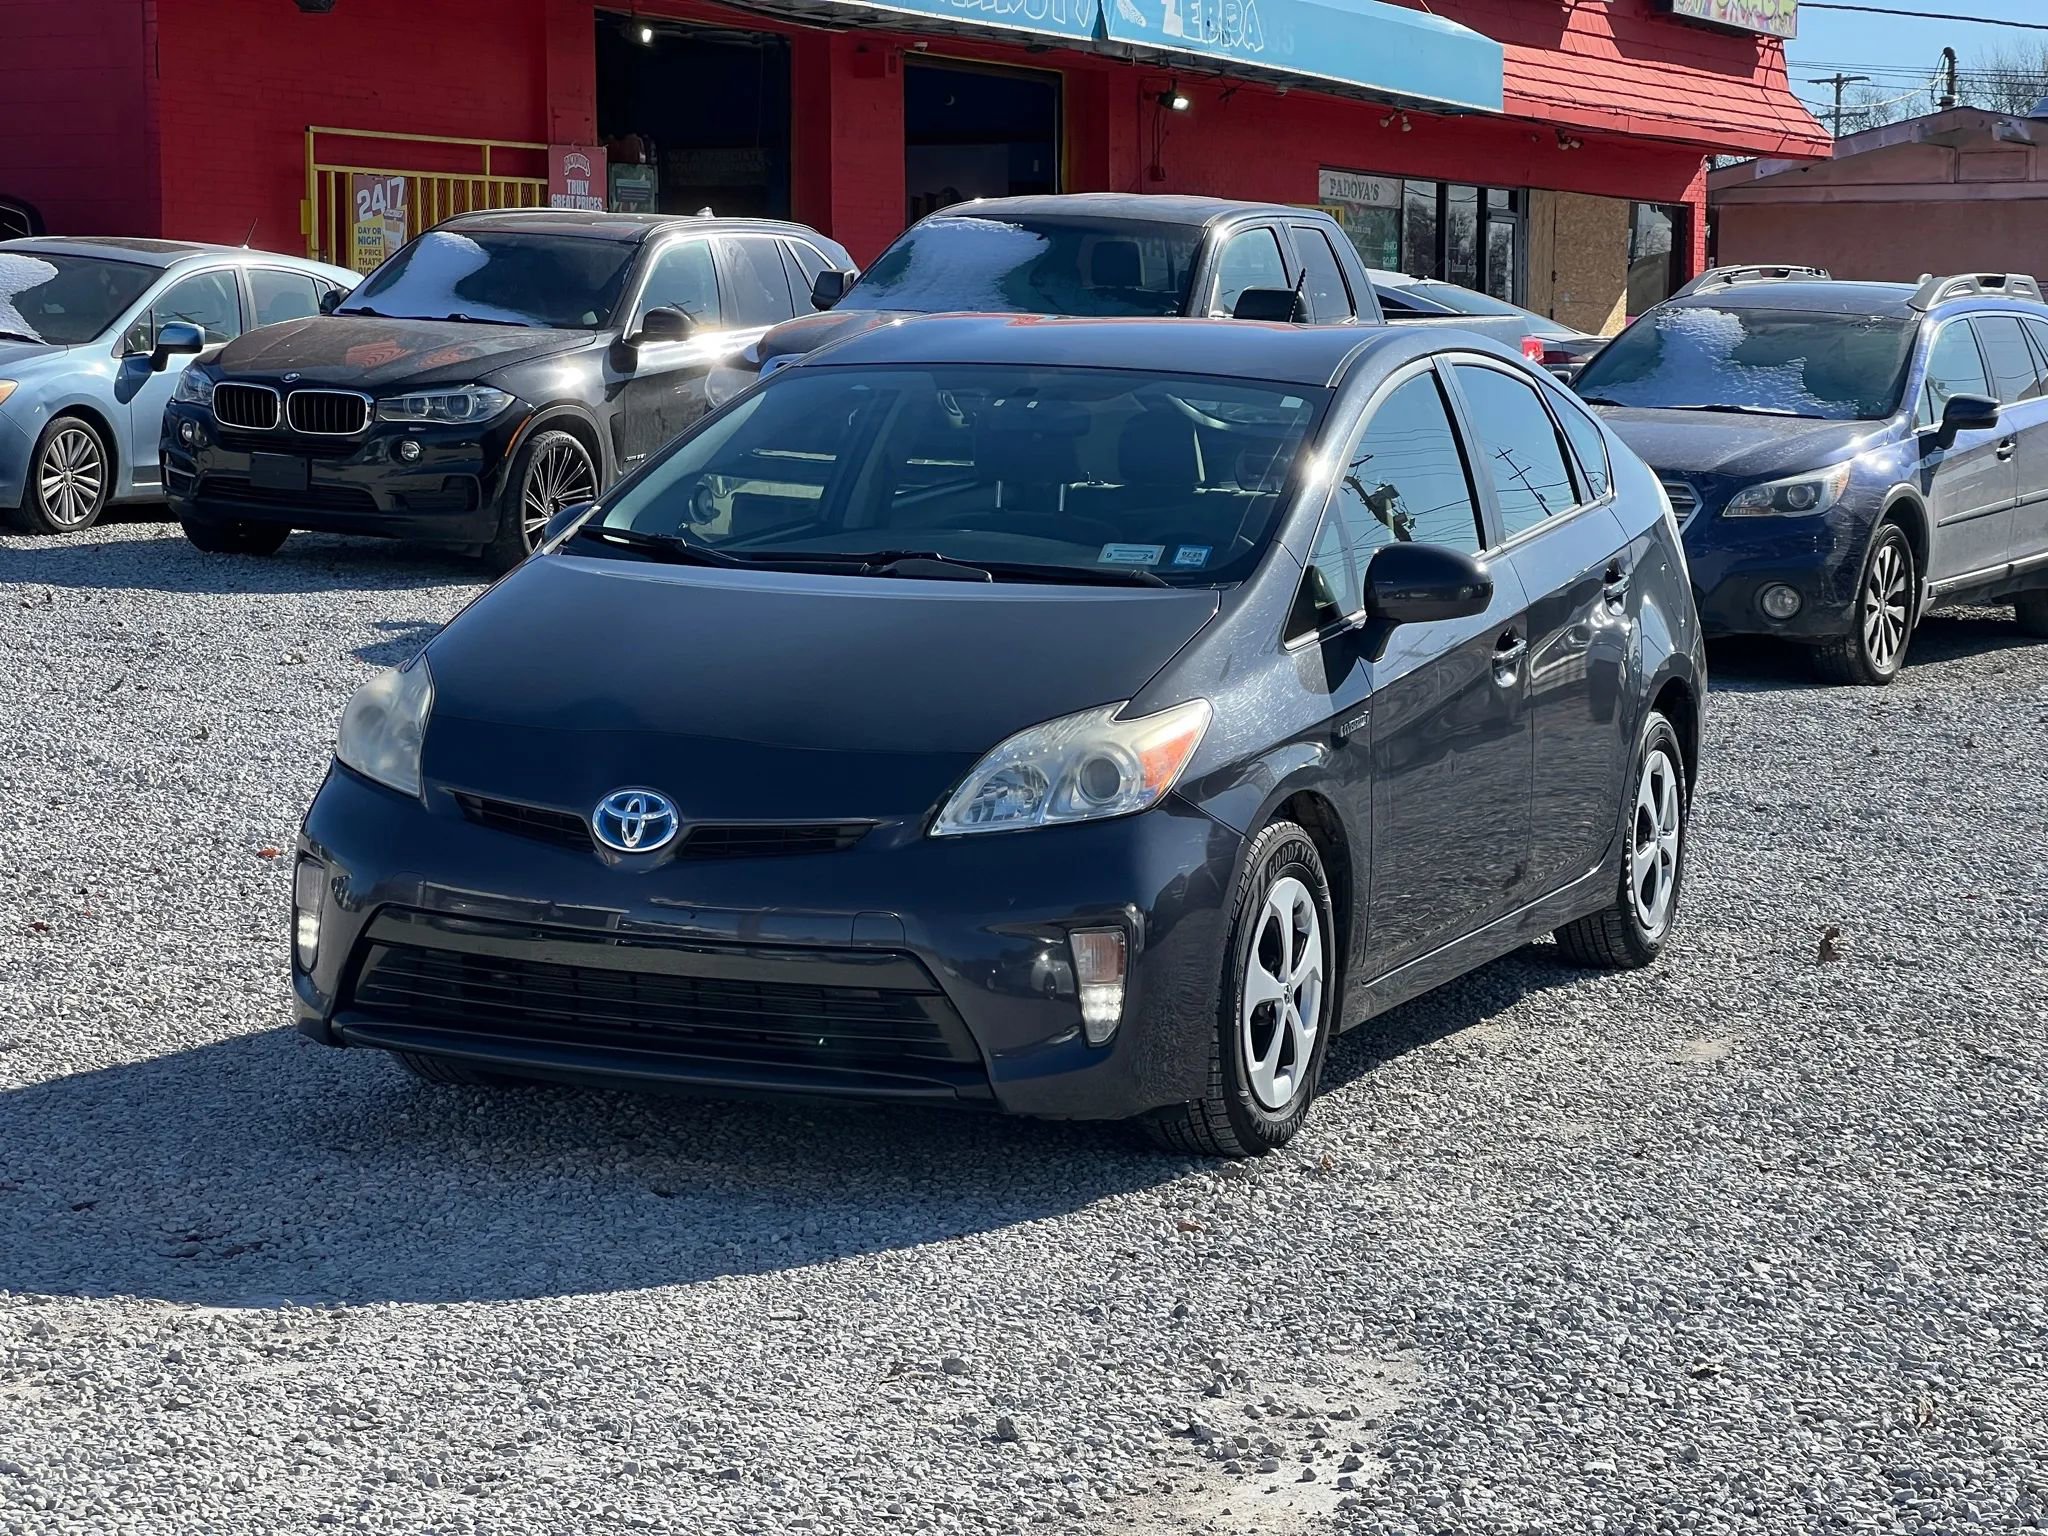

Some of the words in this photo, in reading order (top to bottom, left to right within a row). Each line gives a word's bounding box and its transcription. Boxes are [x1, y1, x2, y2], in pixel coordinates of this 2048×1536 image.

[566, 180, 590, 195] TRULY
[1329, 177, 1380, 201] PADOVA'S
[551, 194, 576, 208] GREAT
[576, 195, 603, 211] PRICES
[372, 227, 382, 235] OR
[357, 236, 382, 246] NIGHT
